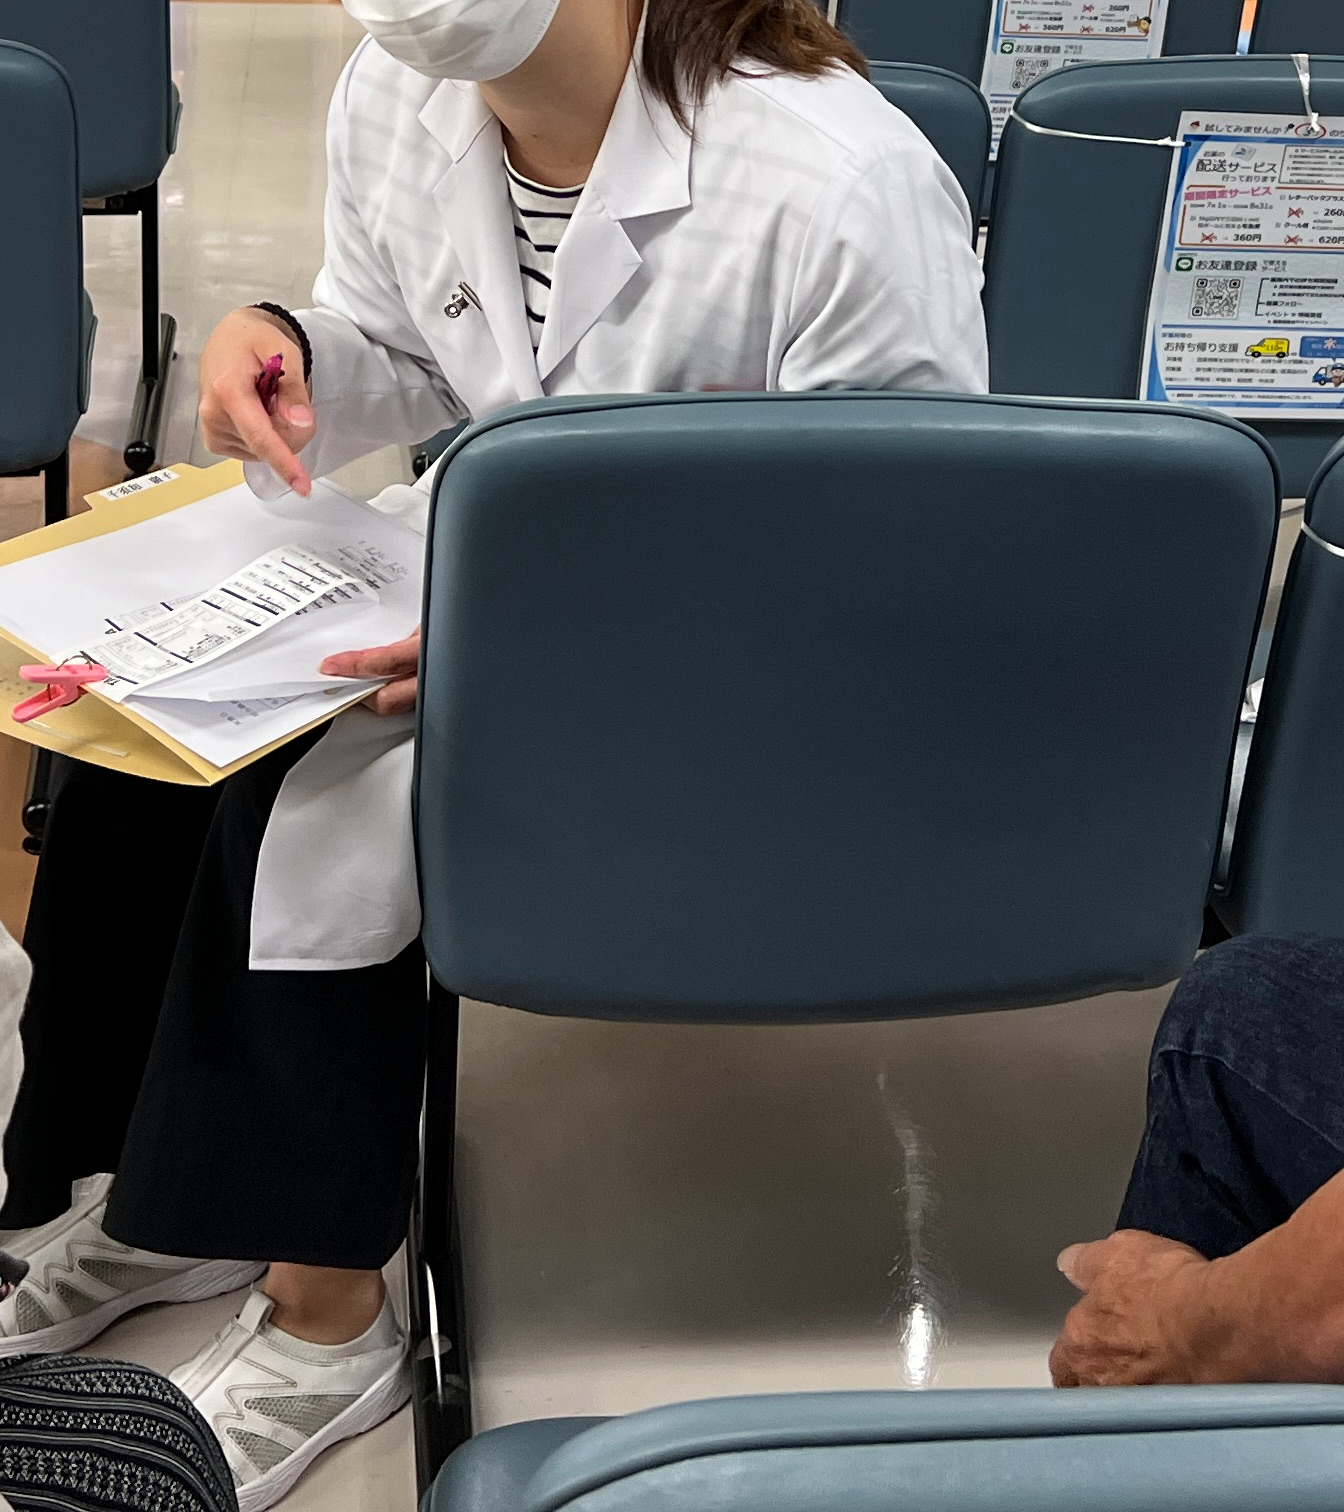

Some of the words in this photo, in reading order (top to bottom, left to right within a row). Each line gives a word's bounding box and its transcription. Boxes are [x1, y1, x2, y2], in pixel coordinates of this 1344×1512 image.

[1196, 159, 1277, 173] 配送サービス
[1221, 174, 1277, 183] 行っております
[1233, 234, 1262, 242] 360円
[1164, 342, 1239, 353] お持ち帰り支援
